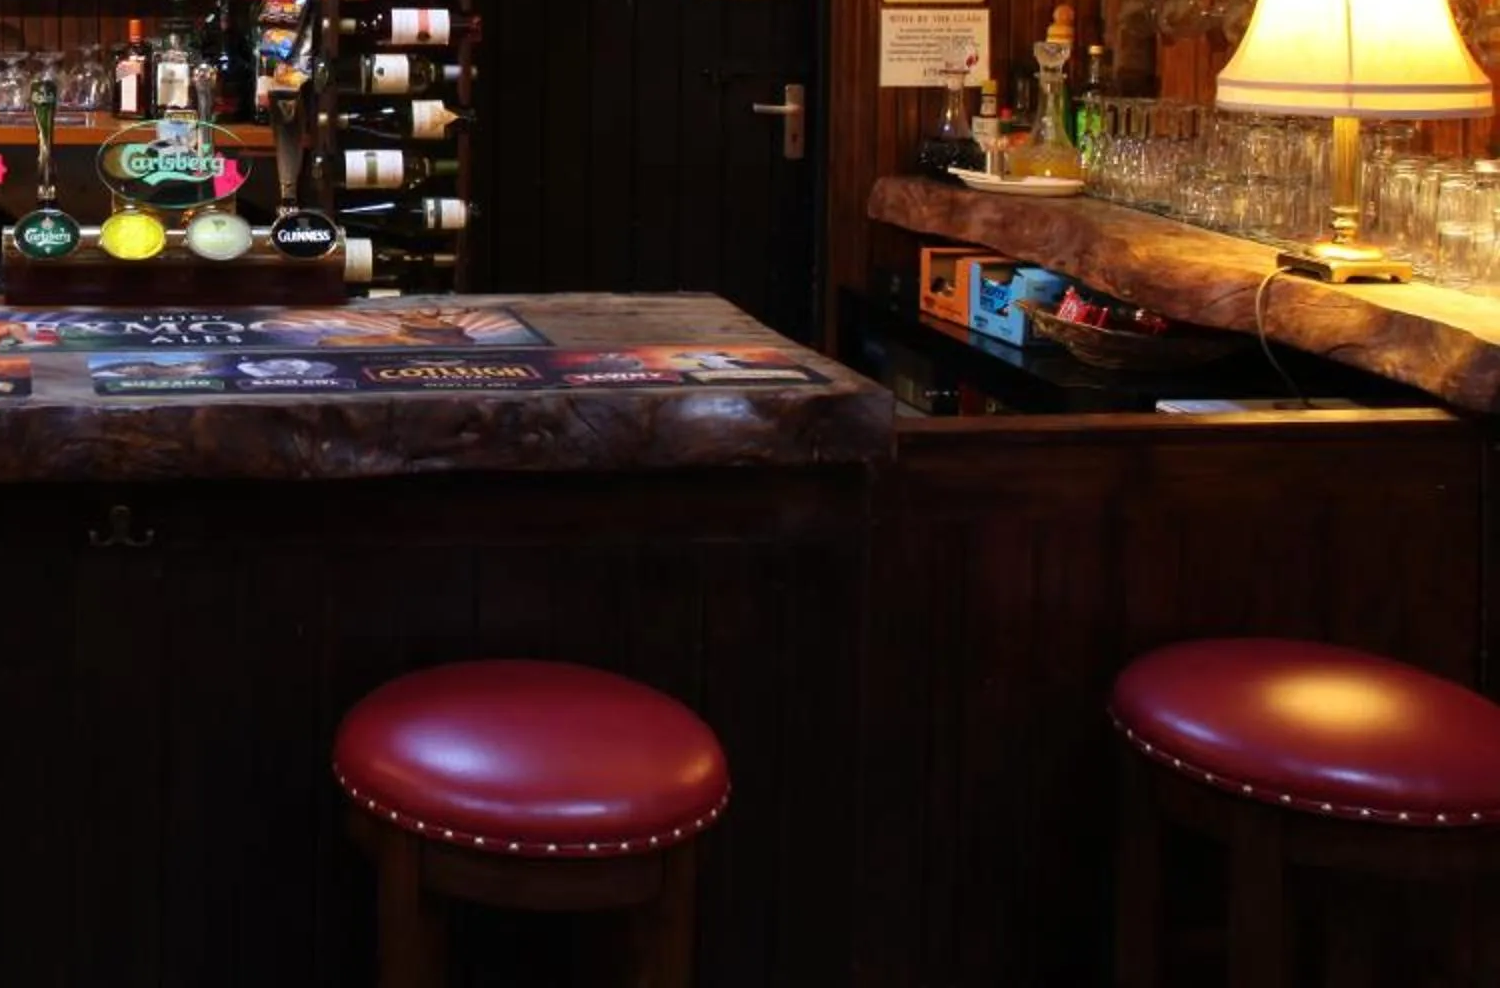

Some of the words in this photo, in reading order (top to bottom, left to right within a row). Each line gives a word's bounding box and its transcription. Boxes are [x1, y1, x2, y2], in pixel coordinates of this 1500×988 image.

[121, 143, 225, 178] Carlsberg
[23, 228, 71, 244] Carlsberg
[277, 228, 331, 243] GUINNESS
[150, 334, 244, 344] ALES
